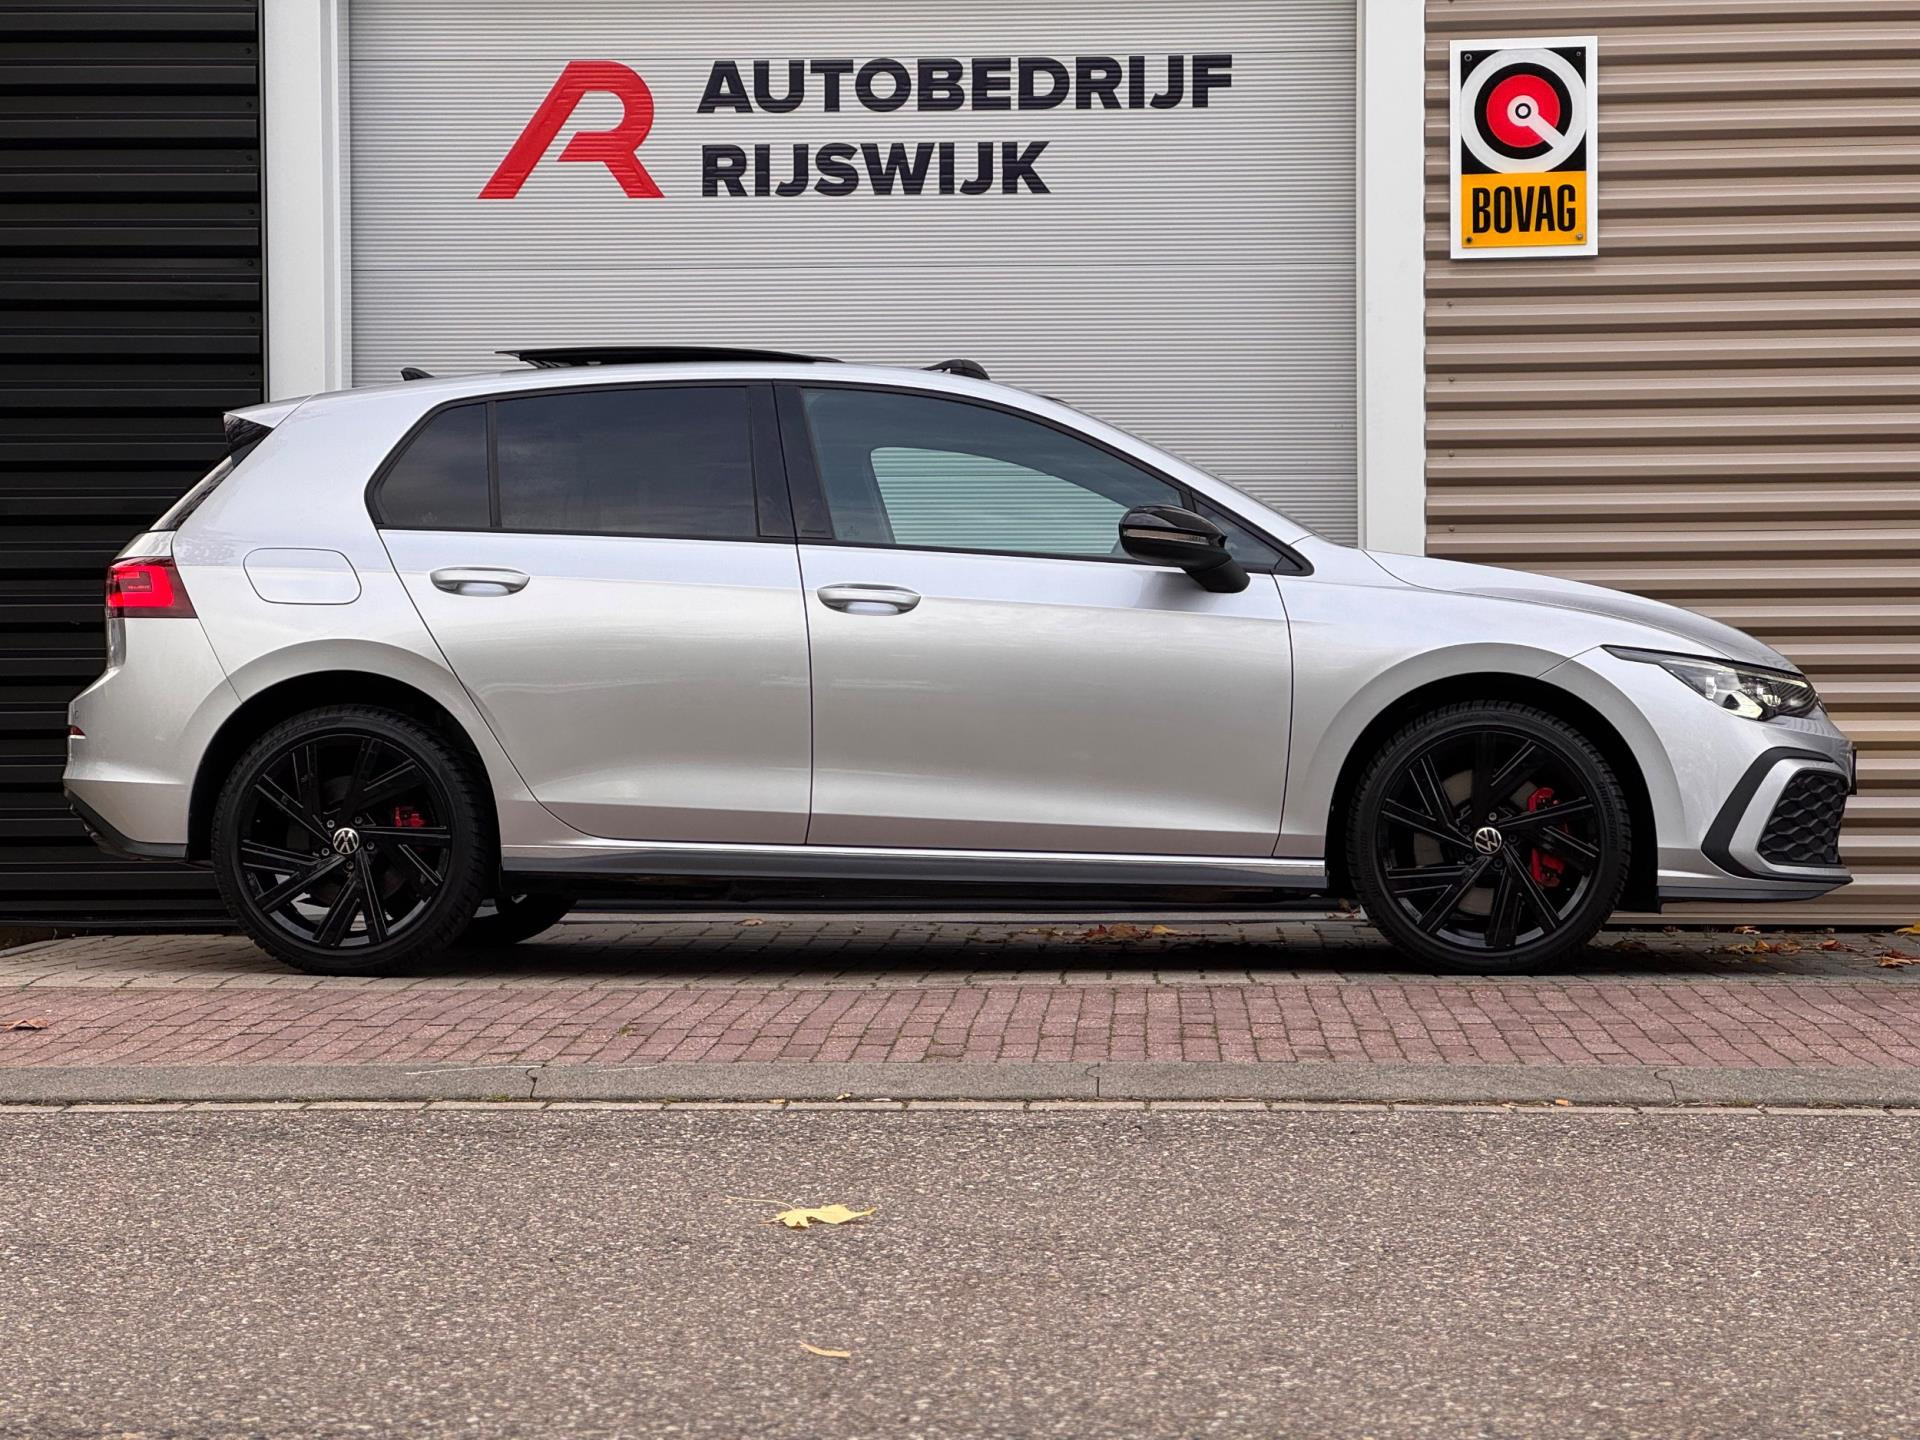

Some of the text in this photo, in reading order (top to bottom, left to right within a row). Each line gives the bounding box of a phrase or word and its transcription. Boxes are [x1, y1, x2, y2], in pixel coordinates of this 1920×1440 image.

[697, 54, 1232, 114] AUTOBEDRIJF
[701, 141, 1051, 198] RIJSWIJK
[1472, 184, 1576, 233] BOVAG
